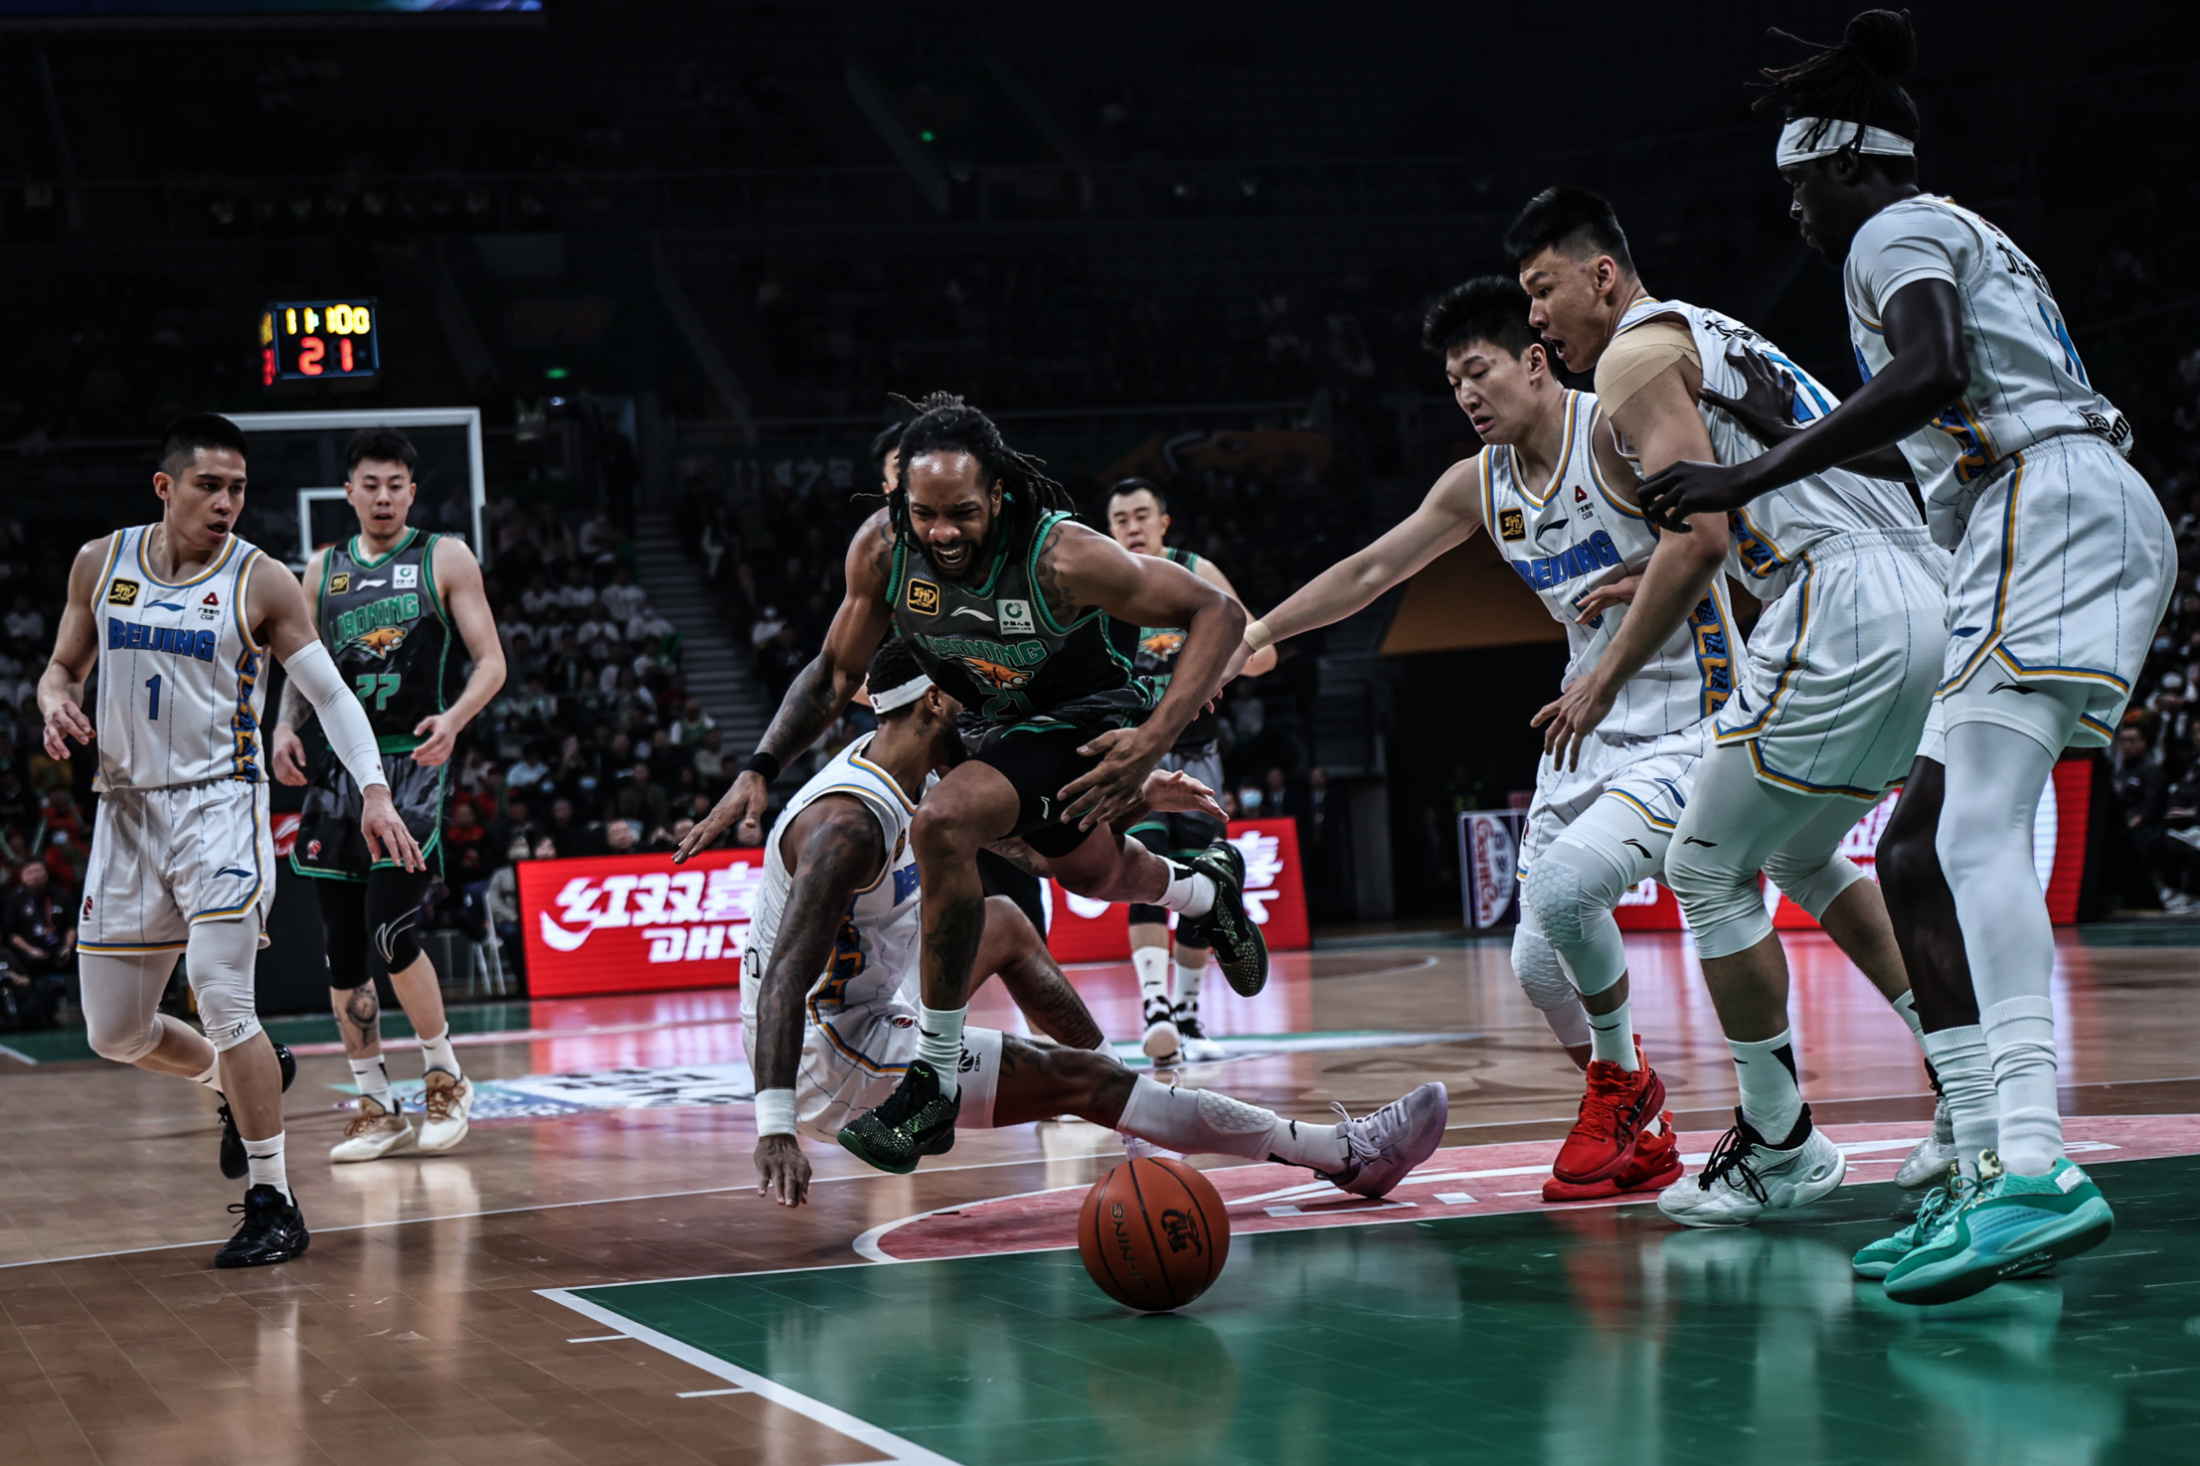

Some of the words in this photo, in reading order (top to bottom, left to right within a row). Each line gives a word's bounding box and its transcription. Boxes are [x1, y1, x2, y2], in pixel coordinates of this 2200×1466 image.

[298, 336, 354, 376] 21
[1511, 529, 1622, 591] BEIJING
[108, 616, 216, 663] BEIJING
[200, 613, 214, 621] CGB
[330, 592, 421, 655] LIAONING
[913, 631, 1047, 667] LIAONING
[145, 674, 162, 721] 1
[555, 861, 763, 928] 红双喜
[642, 923, 749, 963] DHS
[1112, 1203, 1151, 1291] LI-NING
